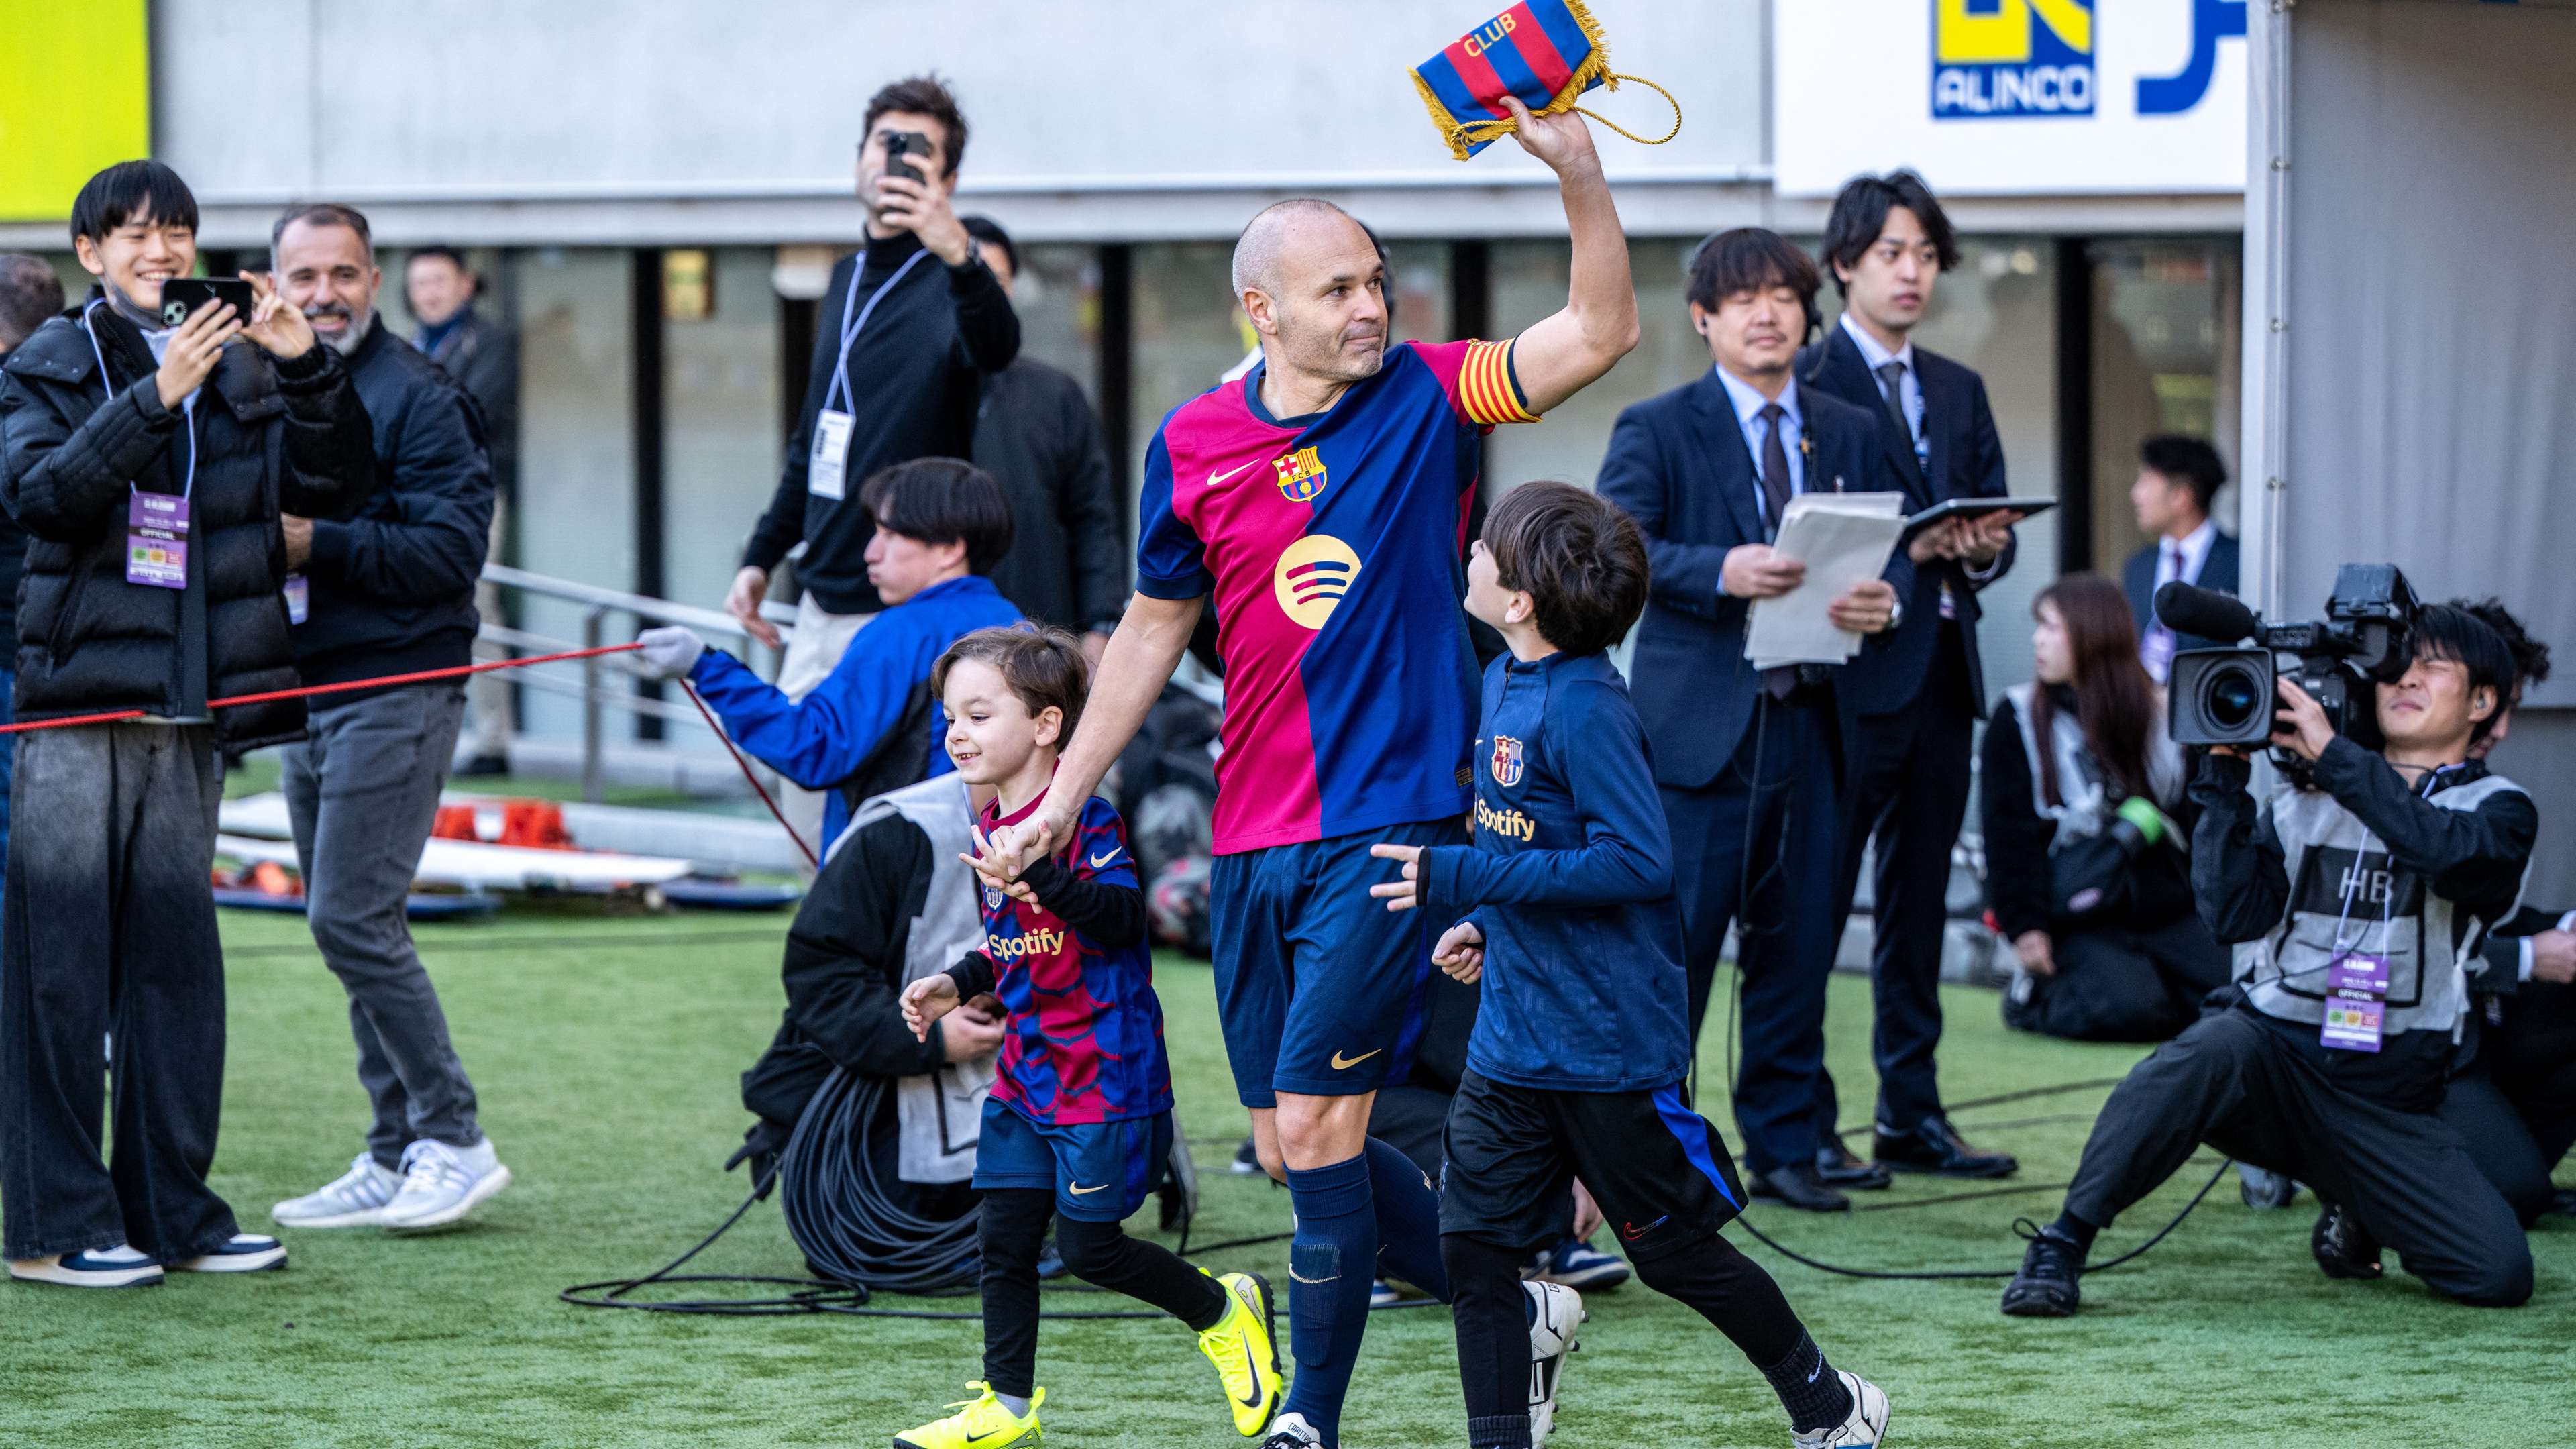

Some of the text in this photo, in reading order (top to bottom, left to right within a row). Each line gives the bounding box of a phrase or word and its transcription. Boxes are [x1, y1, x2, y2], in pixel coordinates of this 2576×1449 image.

[1464, 13, 1517, 57] CLUB
[1936, 65, 2090, 112] ALINCO
[1292, 470, 1311, 481] FCB
[1478, 798, 1535, 841] Spotify
[2338, 866, 2394, 903] HB
[989, 928, 1064, 961] Spotify
[2337, 988, 2373, 1002] OFFICIAL
